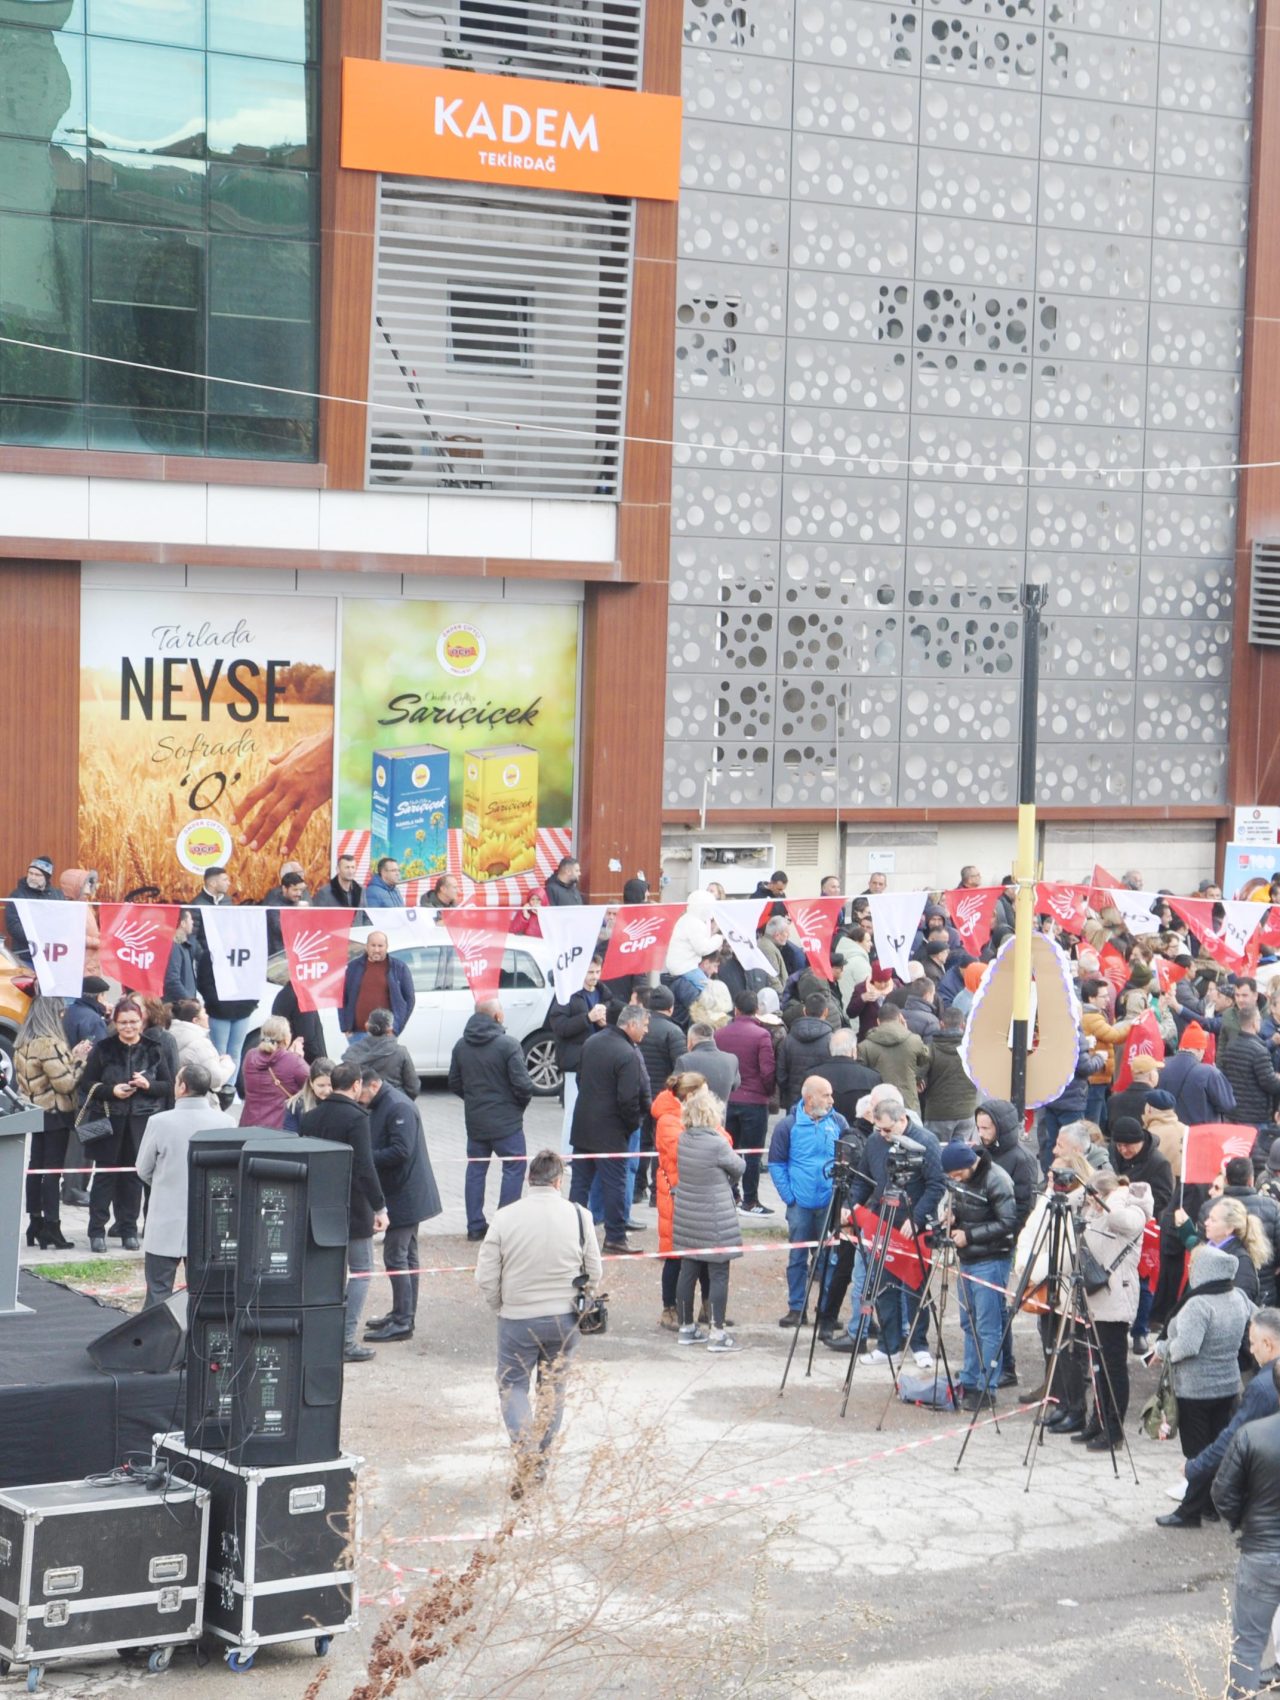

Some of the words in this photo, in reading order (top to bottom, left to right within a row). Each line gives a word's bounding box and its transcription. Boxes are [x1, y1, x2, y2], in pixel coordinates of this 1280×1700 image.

[434, 95, 599, 152] KADEM
[478, 151, 556, 172] TEKİRDAĞ
[151, 618, 256, 651] Tarlada
[120, 656, 291, 723] NEYSE
[377, 693, 543, 731] Sarıçiçek
[151, 728, 257, 771] Sofrada
[116, 947, 155, 970] CHP
[556, 946, 583, 971] CHP
[619, 936, 657, 953] CHP
[295, 961, 329, 980] CHP
